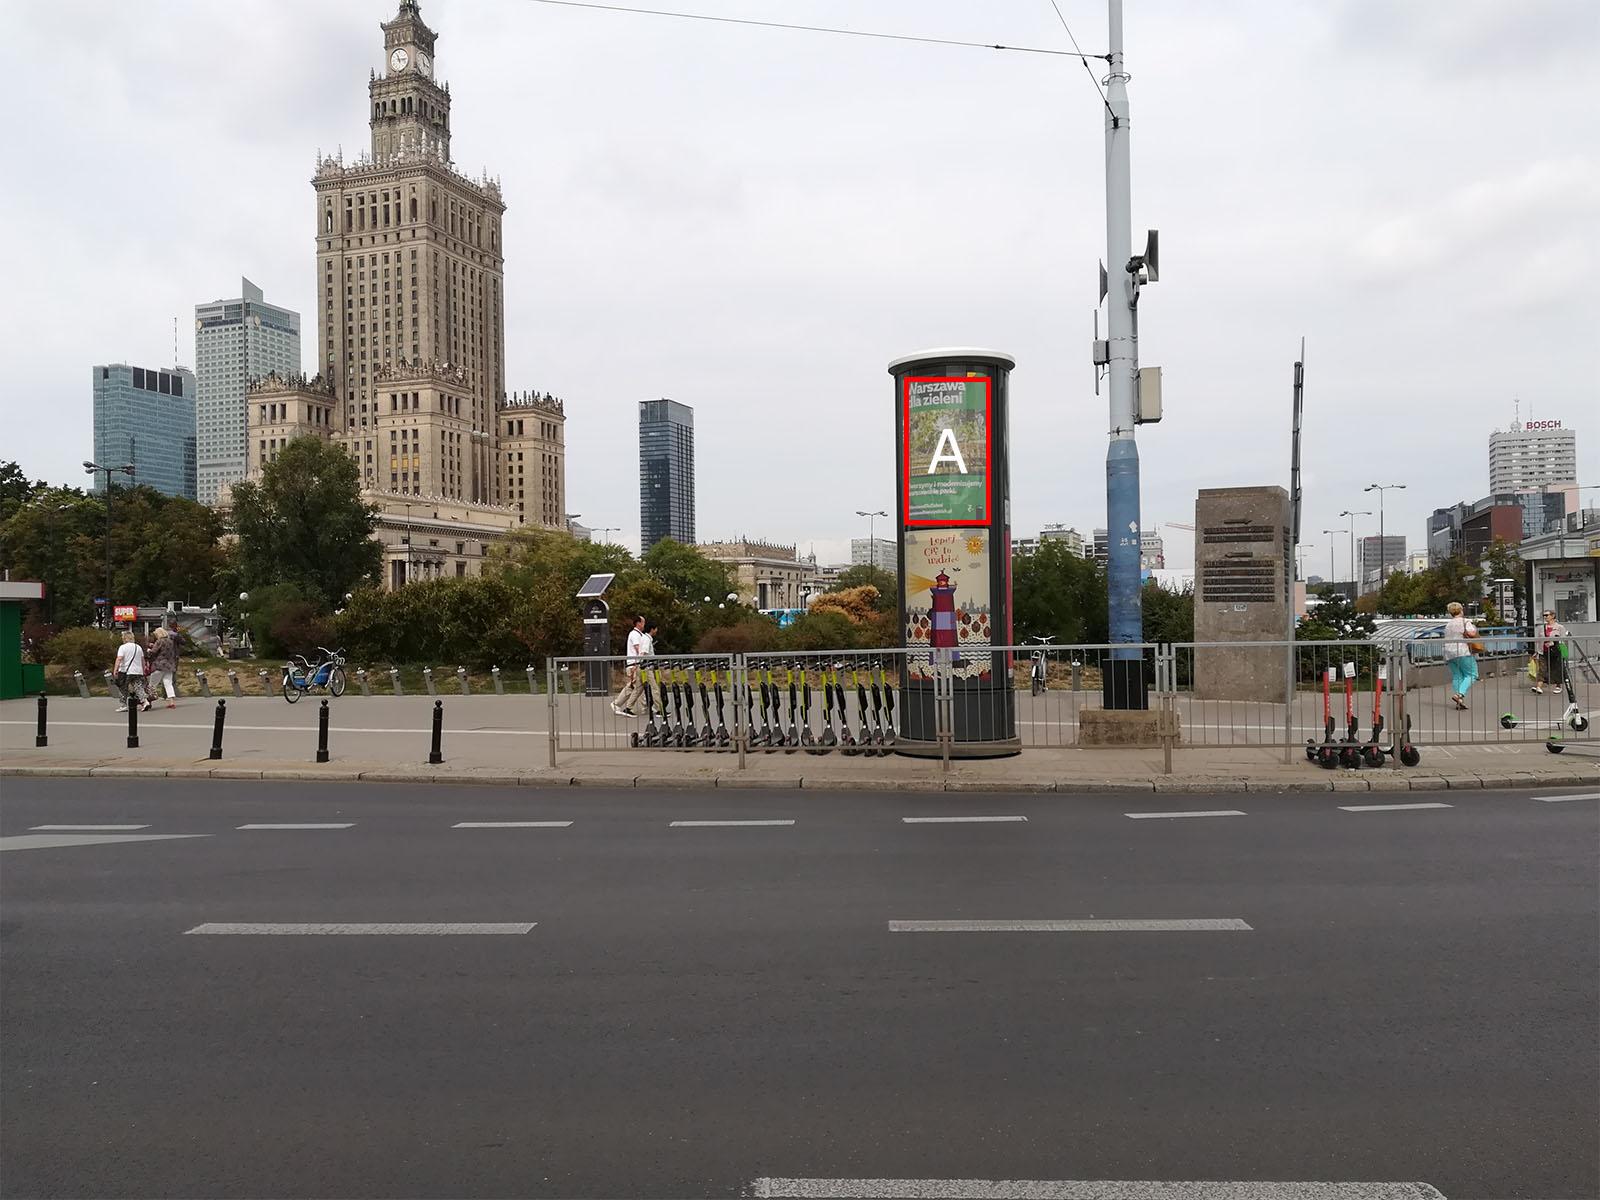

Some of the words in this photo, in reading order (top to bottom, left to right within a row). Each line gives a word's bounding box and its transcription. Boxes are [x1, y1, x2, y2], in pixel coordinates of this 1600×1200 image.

[923, 391, 963, 406] zieleni
[1526, 420, 1561, 429] BOSCH
[115, 608, 134, 616] SUPER
